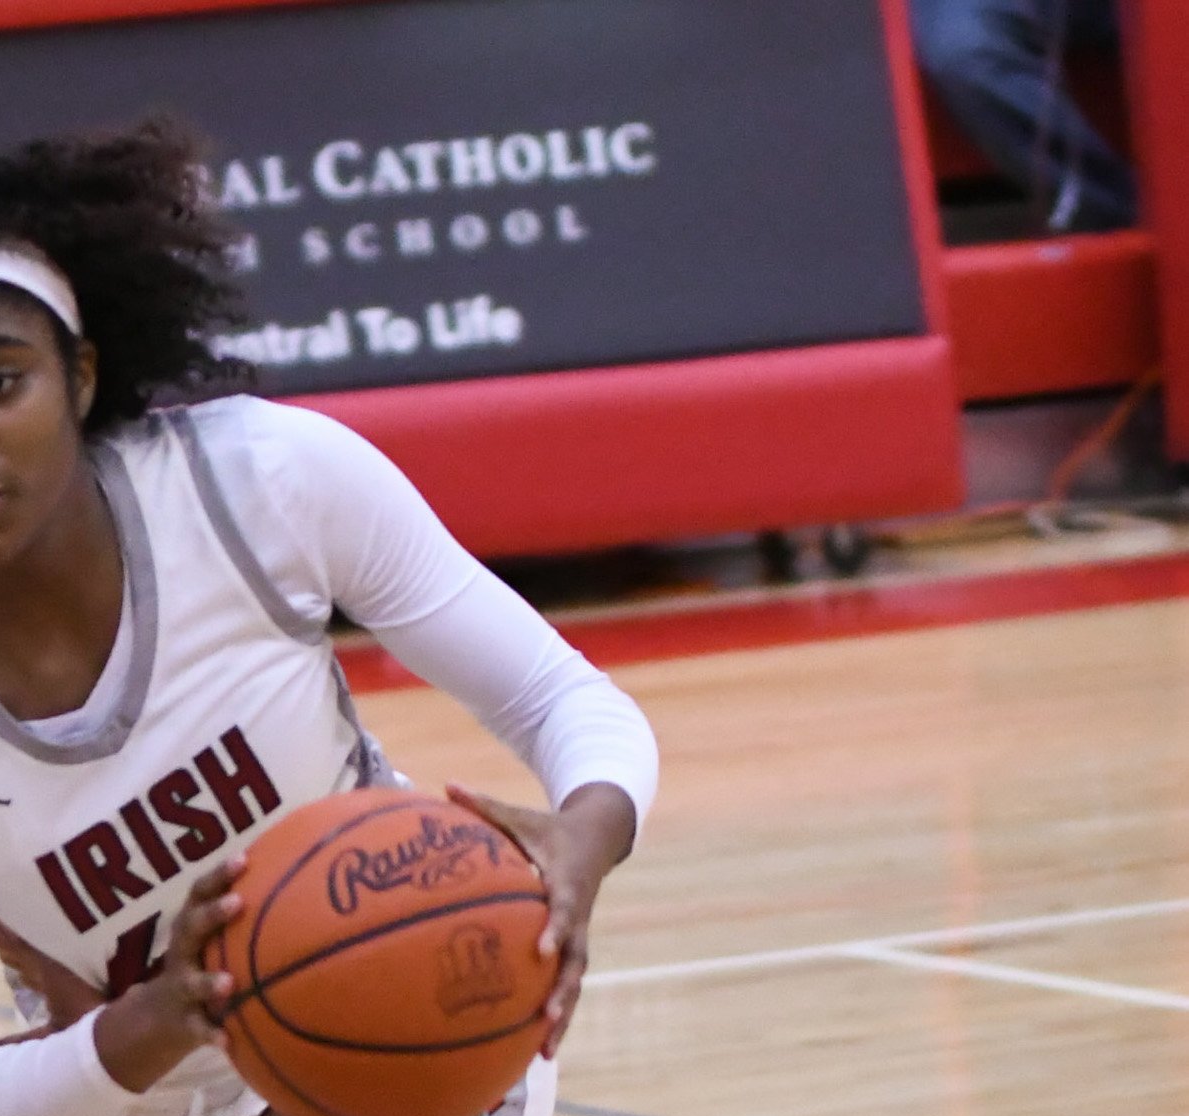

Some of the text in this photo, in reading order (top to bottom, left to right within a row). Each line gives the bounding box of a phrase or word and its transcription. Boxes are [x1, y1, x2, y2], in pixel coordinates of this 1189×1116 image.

[313, 122, 656, 199] CATHOLIC
[301, 204, 589, 264] SCHOOL
[202, 295, 524, 366] entral To Life
[36, 725, 282, 934] IRISH
